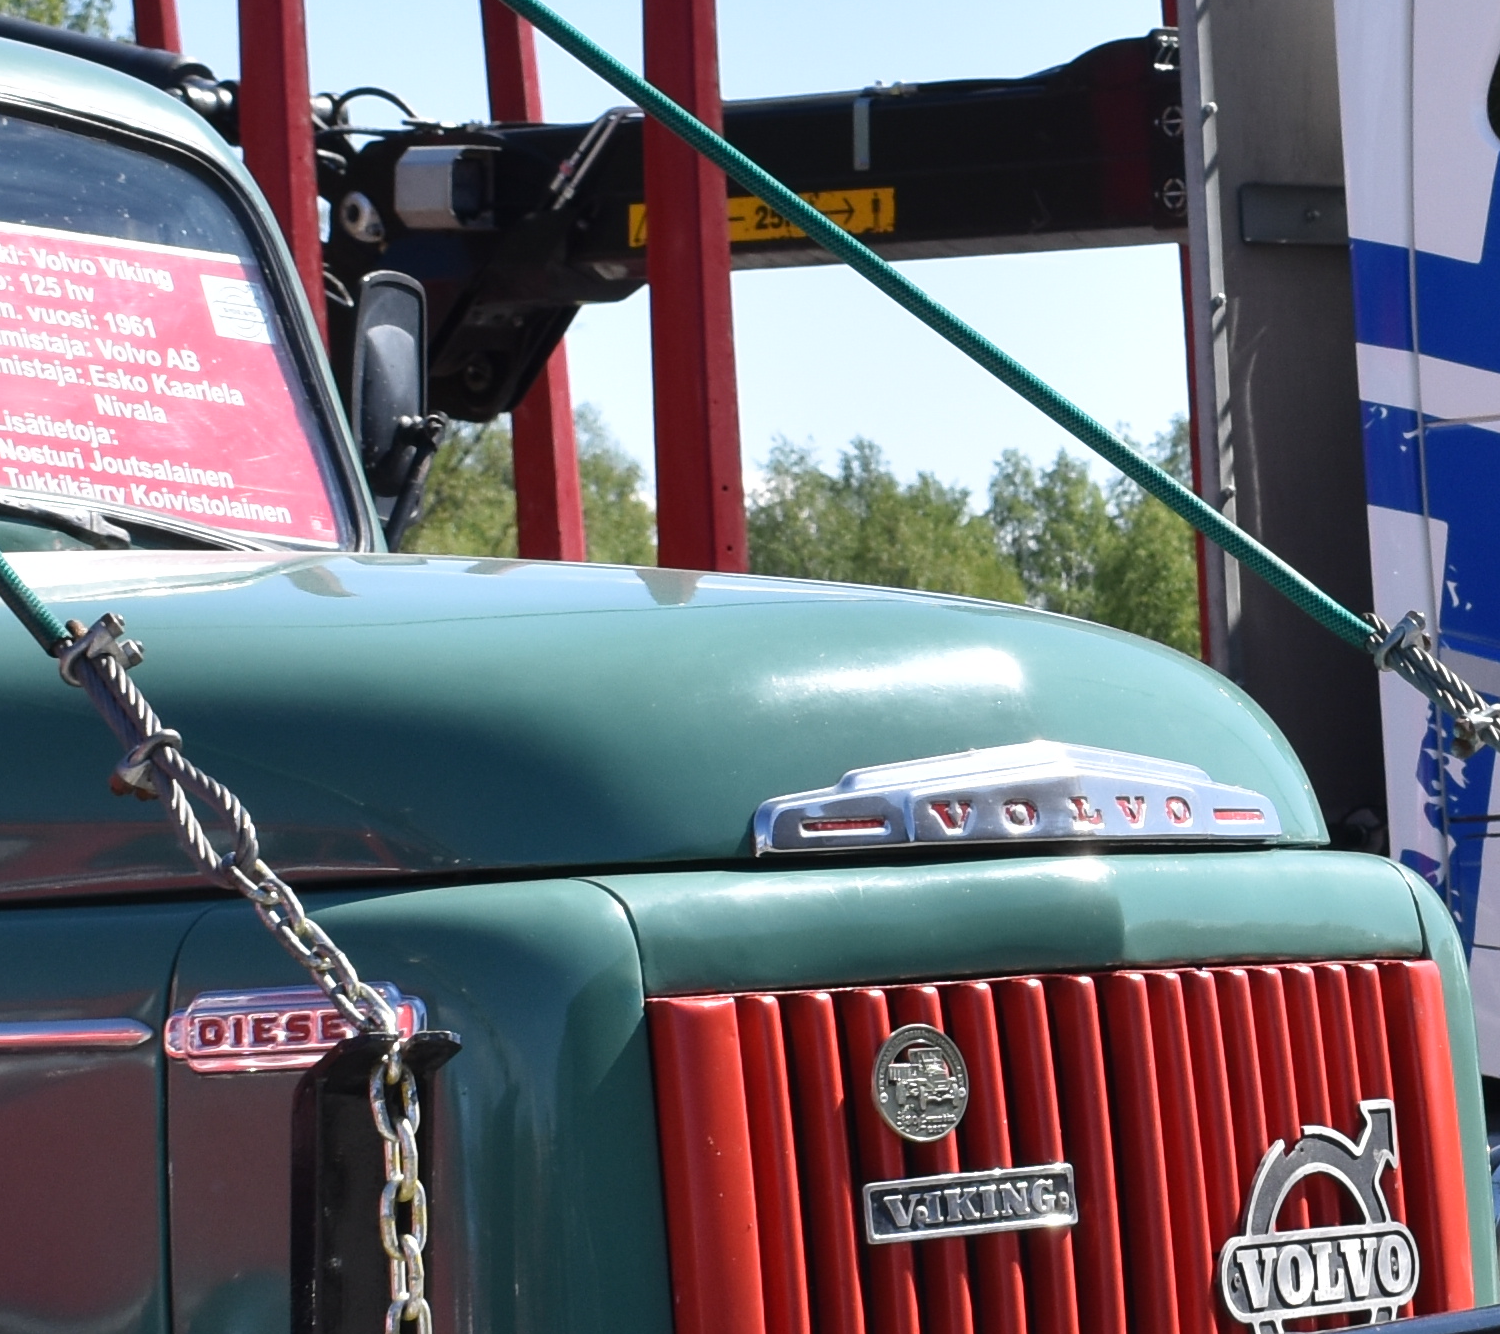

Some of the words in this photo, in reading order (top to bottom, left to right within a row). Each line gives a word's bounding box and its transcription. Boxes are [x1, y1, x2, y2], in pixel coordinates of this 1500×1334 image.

[19, 273, 61, 298] 125
[65, 279, 94, 302] hv
[29, 247, 97, 276] Volvo
[98, 257, 174, 292] Viking
[26, 305, 99, 331] vuosi:
[104, 312, 156, 338] 1961
[95, 338, 161, 367] Volvo
[167, 348, 201, 372] AB
[89, 365, 148, 393] Esko
[151, 373, 245, 406] Kaarlela
[94, 393, 168, 423] Nivala
[90, 450, 234, 489] Joutsalainen
[130, 483, 292, 524] Koivistolainen
[929, 796, 1194, 835] VOLVO
[199, 1010, 352, 1047] DIESE
[883, 1179, 1056, 1227] VIKING
[1236, 1234, 1412, 1309] VOLVO
